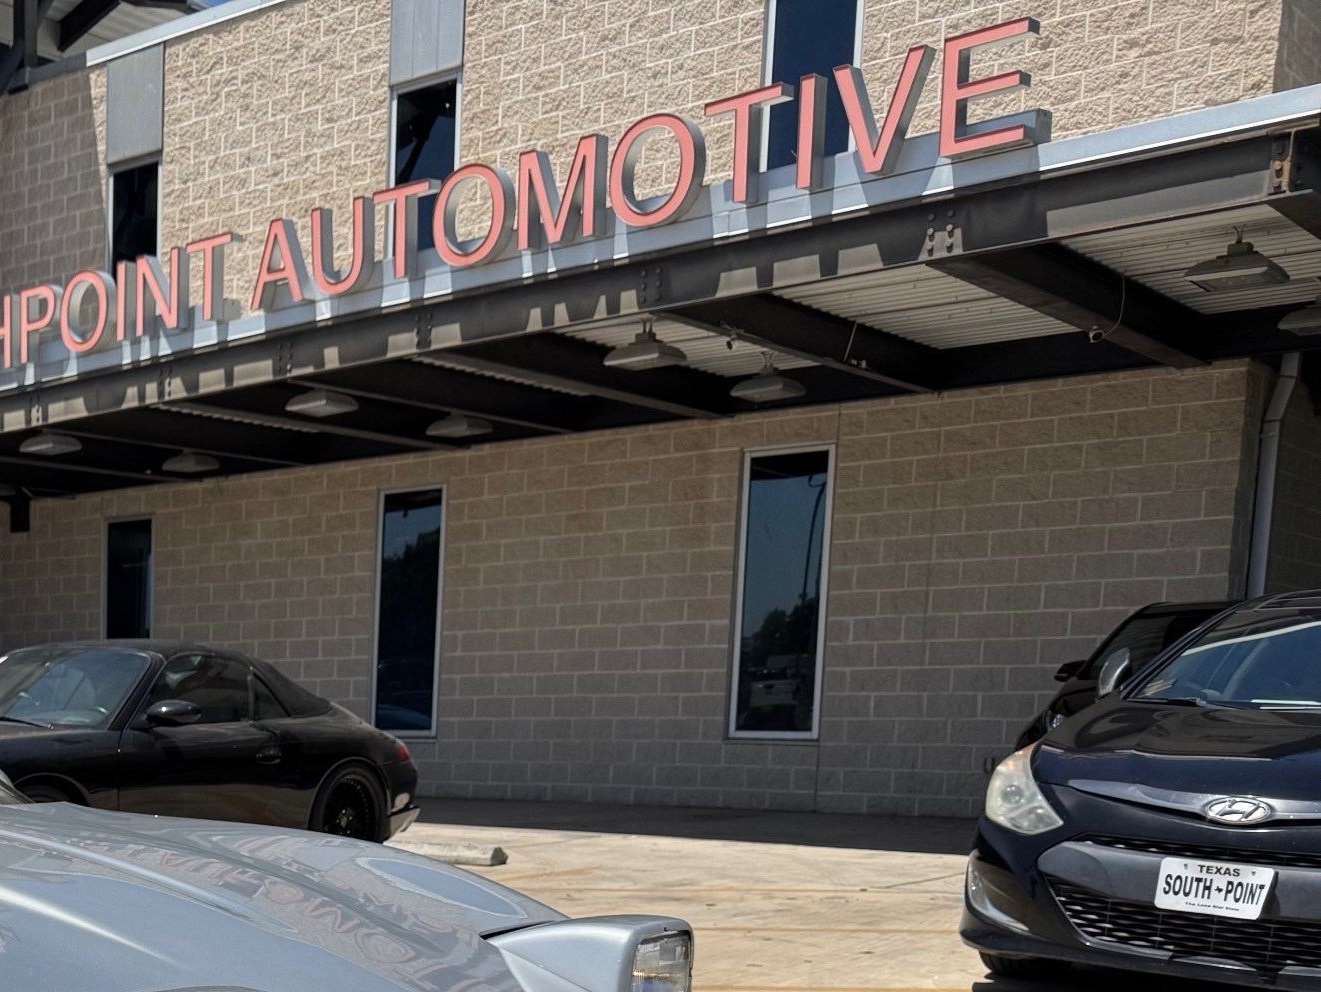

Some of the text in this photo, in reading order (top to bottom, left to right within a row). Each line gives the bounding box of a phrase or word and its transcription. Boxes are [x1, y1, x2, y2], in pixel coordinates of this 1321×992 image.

[250, 16, 1044, 311] AUTOMOTIVE
[1197, 864, 1241, 877] TEXAS
[1162, 873, 1266, 906] SOUTH POINT
